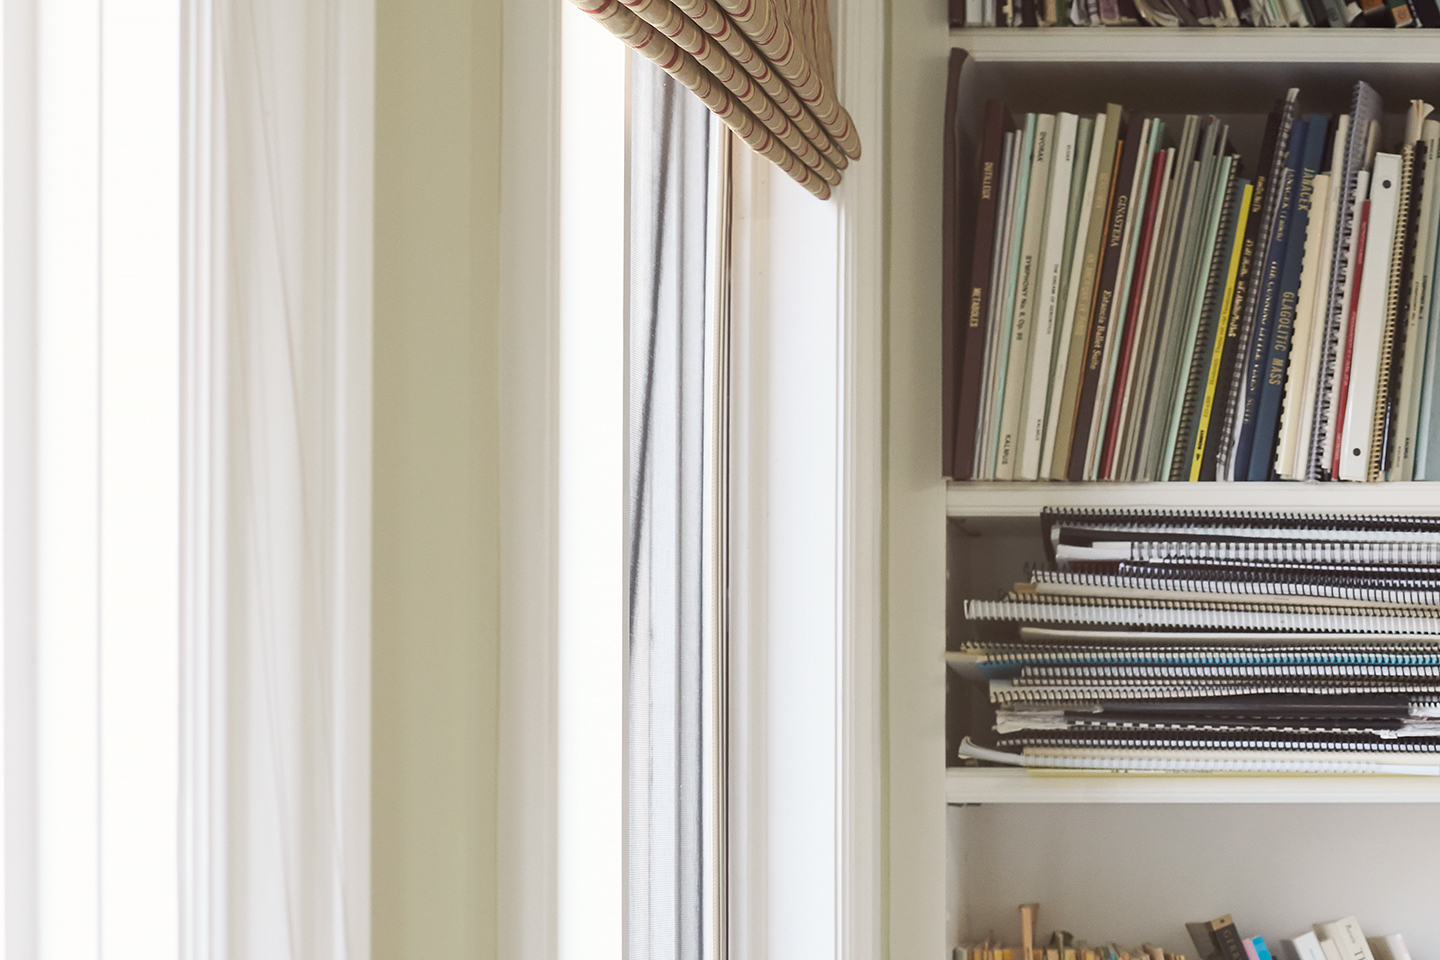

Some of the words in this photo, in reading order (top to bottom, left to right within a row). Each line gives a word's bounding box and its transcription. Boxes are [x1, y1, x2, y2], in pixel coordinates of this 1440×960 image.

[1036, 132, 1047, 162] DVORAK
[1297, 167, 1315, 211] JANACEK
[1110, 195, 1128, 247] GINASTERA
[1021, 255, 1033, 297] SYMPHONY
[969, 288, 982, 327] METABOLES
[1096, 290, 1112, 324] Estancia
[1275, 291, 1295, 351] GLAGOLITIC
[1091, 325, 1105, 349] Ballet
[1089, 349, 1103, 370] Suite
[1268, 358, 1284, 385] MASS
[1001, 434, 1012, 465] KALMUS
